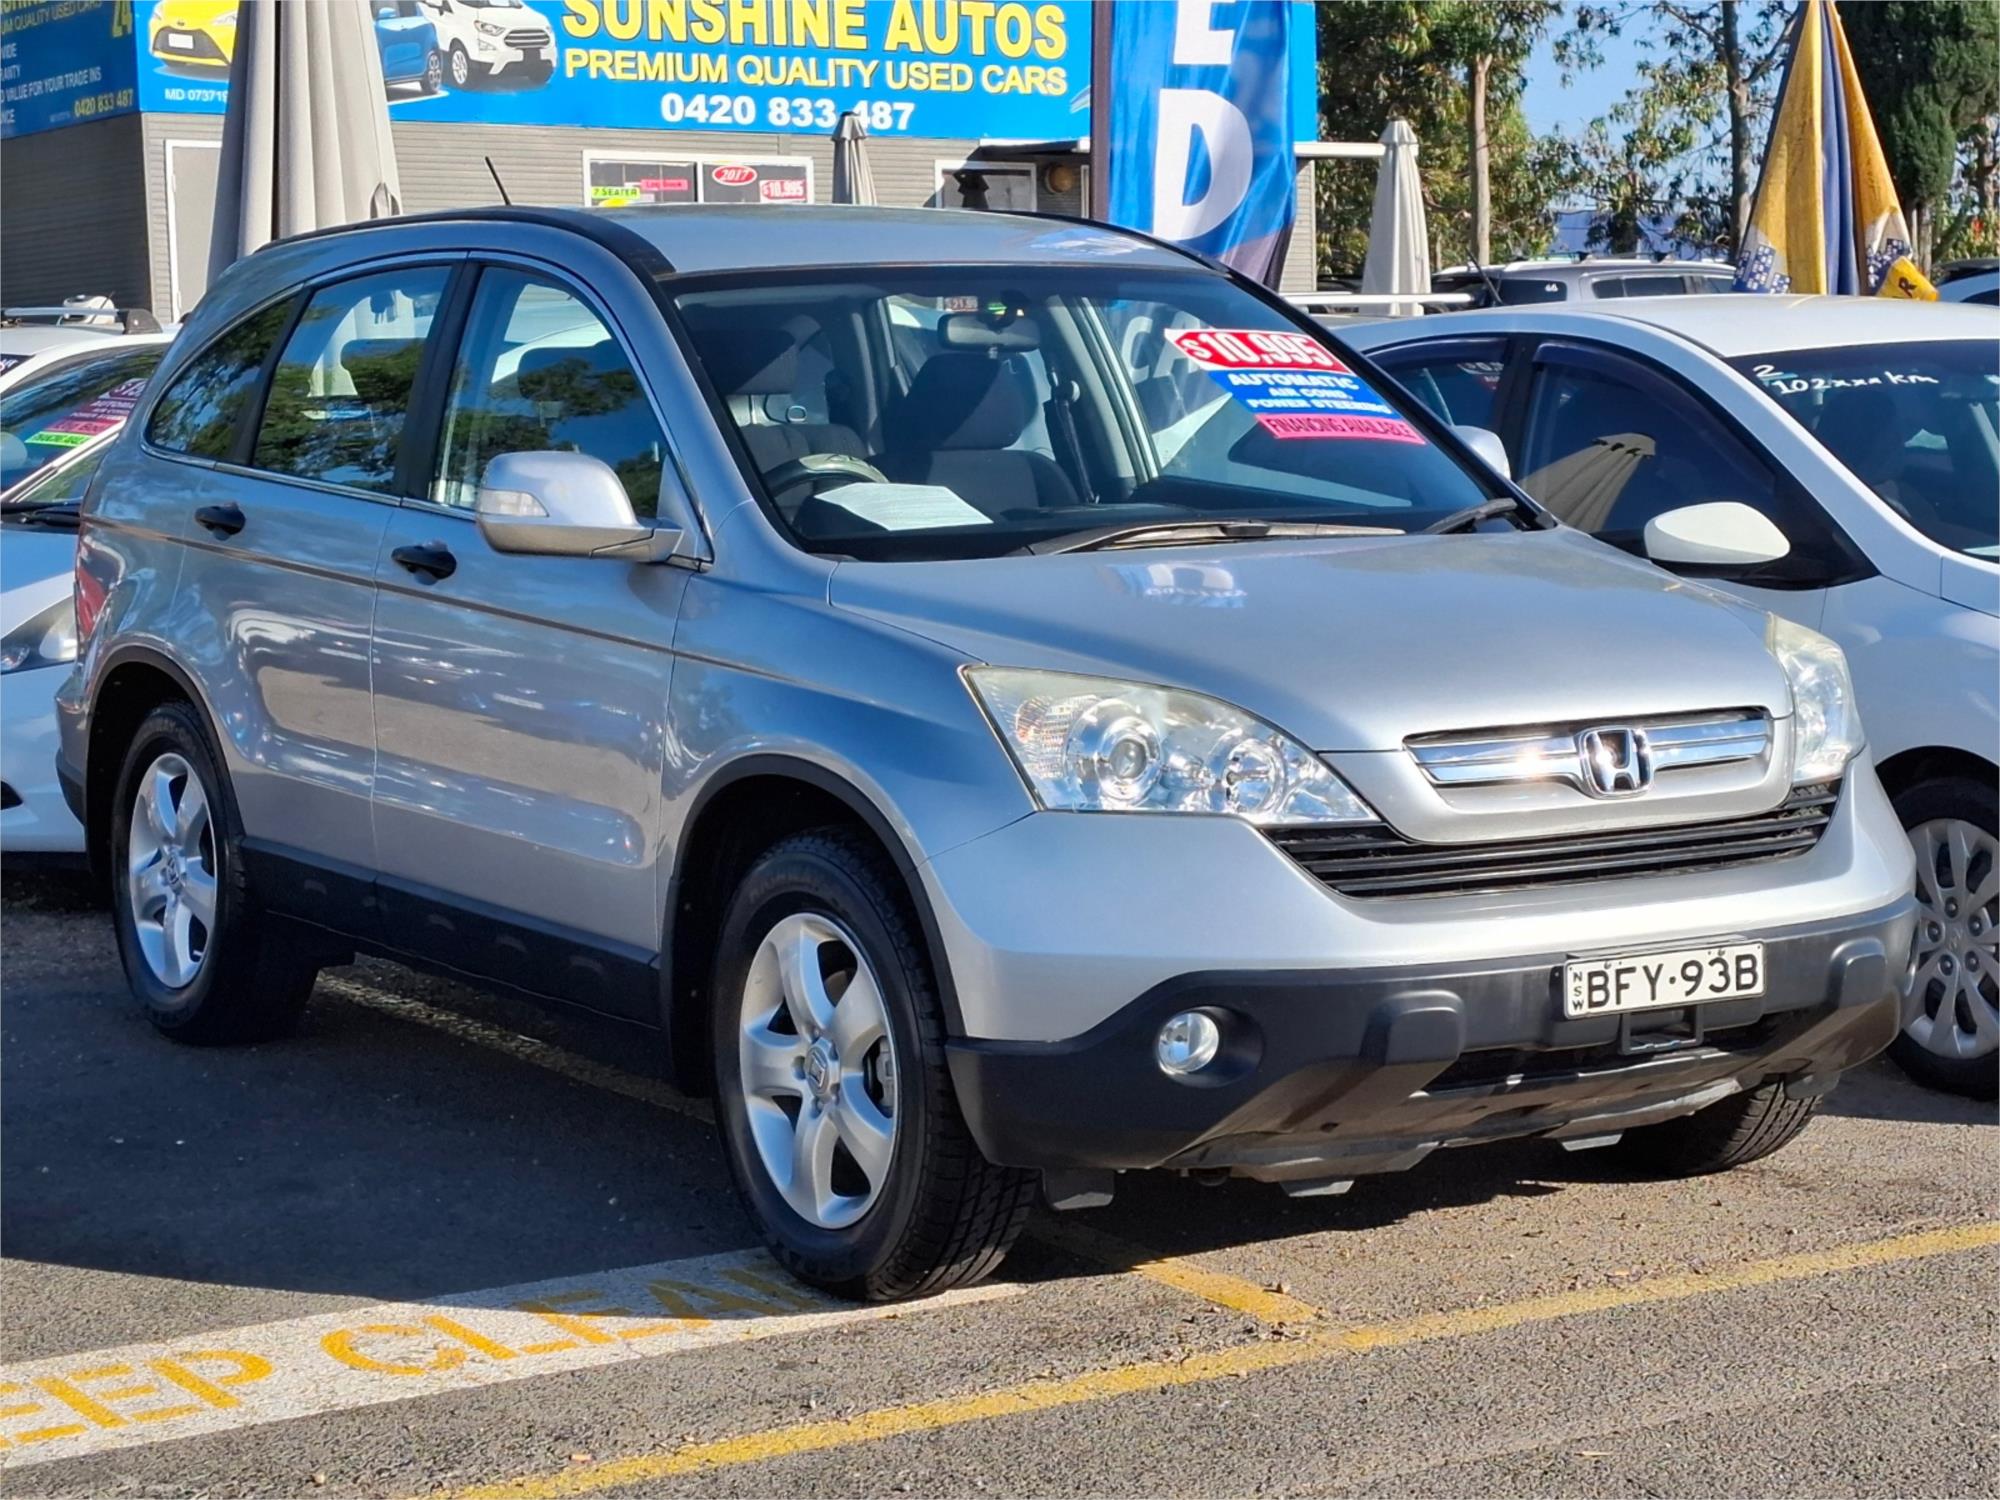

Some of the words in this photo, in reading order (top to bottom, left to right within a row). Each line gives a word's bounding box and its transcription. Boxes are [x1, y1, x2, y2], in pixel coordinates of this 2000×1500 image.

[562, 0, 867, 48] SUNSHINE
[884, 0, 1067, 60] AUTOS
[565, 48, 728, 83] PREMIUM
[737, 55, 879, 88] QUALITY
[885, 60, 973, 92] USED
[981, 65, 1068, 96] CARS
[164, 88, 185, 100] MD
[74, 97, 96, 117] 0420
[97, 92, 114, 112] 833
[116, 88, 134, 107] 487
[660, 92, 756, 124] 0420
[768, 96, 836, 128] 833
[719, 168, 750, 181] 2017
[1752, 363, 1785, 378] 2
[1884, 370, 1940, 385] km
[1227, 373, 1360, 391] AUTOMATIC
[1268, 388, 1298, 397] AIR
[1246, 398, 1312, 409] POWER
[1264, 417, 1344, 434] FINANCING
[1343, 418, 1416, 440] AVAILABLE
